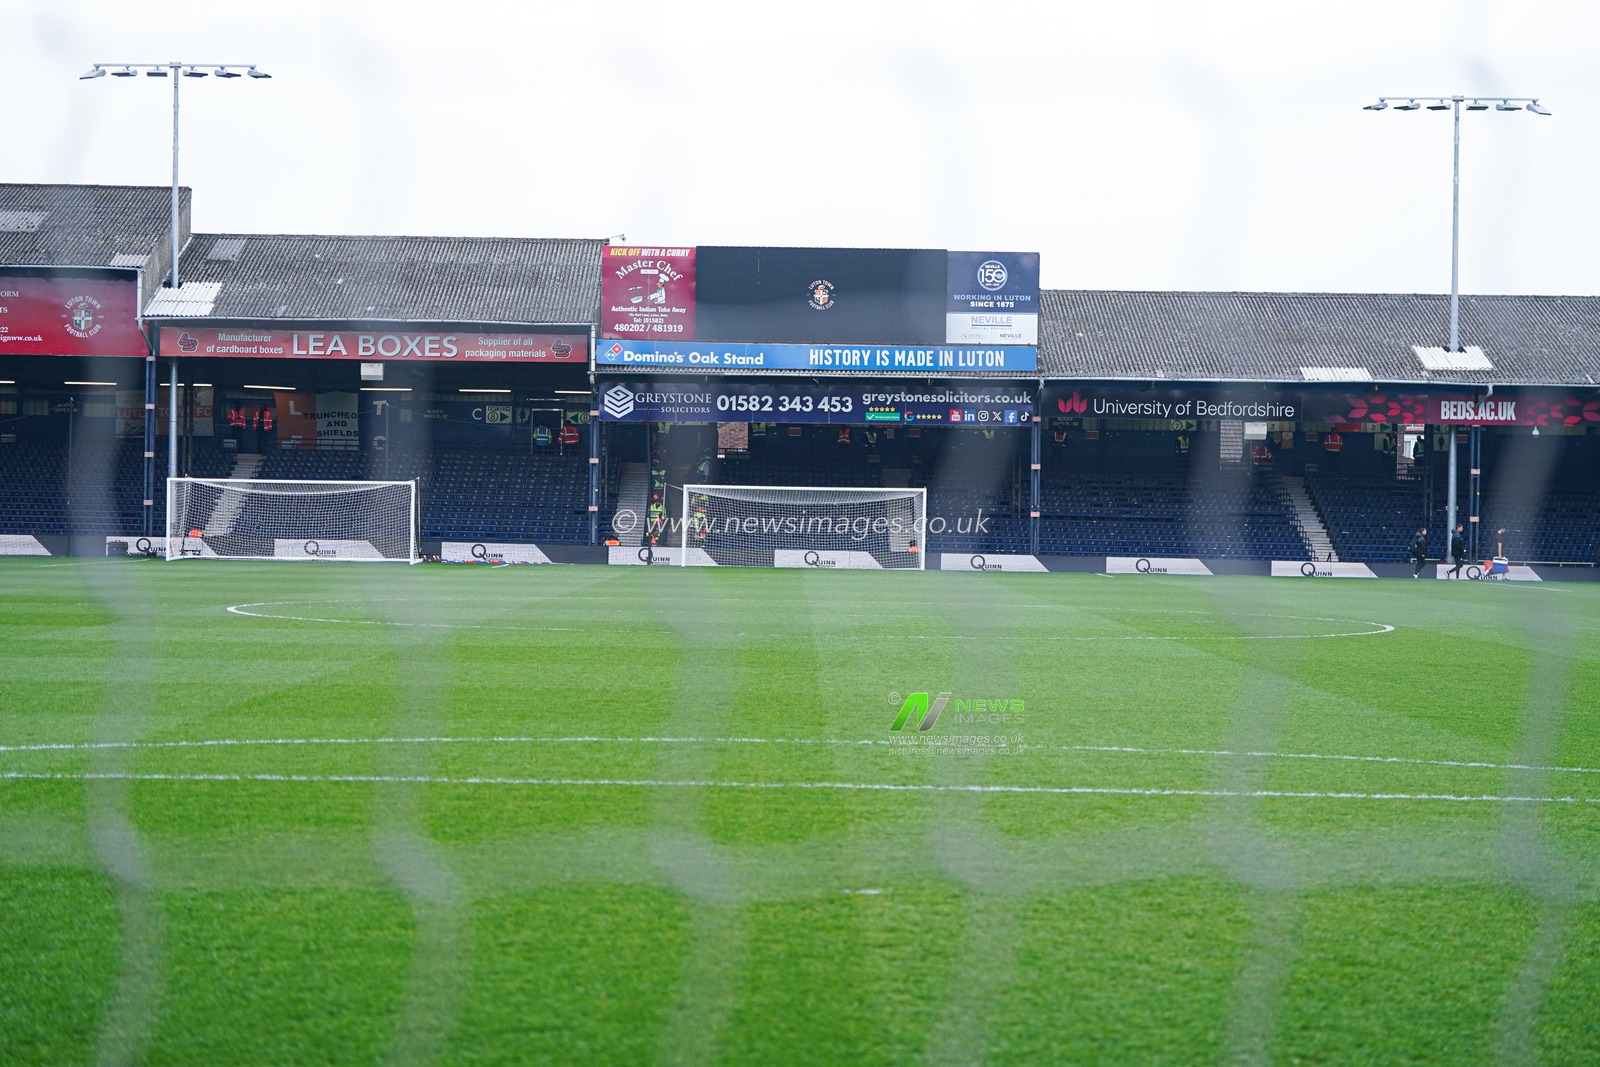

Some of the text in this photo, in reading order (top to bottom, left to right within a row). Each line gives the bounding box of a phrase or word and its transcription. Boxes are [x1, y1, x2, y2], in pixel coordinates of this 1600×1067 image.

[610, 247, 627, 256] KICK
[628, 248, 641, 256] OFF
[642, 248, 659, 256] WITH
[615, 260, 683, 281] Master Chef
[980, 269, 1006, 283] 150
[808, 280, 834, 290] LUTON TOWN
[65, 296, 102, 309] LUTON TOWN
[64, 323, 102, 338] FOOTBALL CLUB
[218, 333, 272, 342] Manufacturer
[206, 345, 283, 354] of cardboard boxes
[292, 334, 459, 359] LEA BOXES
[478, 337, 533, 348] Supplier of all
[465, 348, 546, 359] packaging materials
[623, 350, 764, 365] Domino's Oak Stand
[810, 349, 1004, 367] HISTORY IS MADE IN LUTON
[635, 393, 853, 413] GREYSTONE 01582 343 453
[862, 391, 1032, 405] greystonesolicitors.co.uk
[117, 407, 212, 418] LUTO TOW FC
[372, 400, 387, 415] T
[472, 408, 482, 420] C
[1094, 398, 1295, 419] University of Bedfordshire
[1441, 401, 1516, 420] BEDS.AC.UK
[303, 411, 357, 420] TRUNCHEO
[373, 436, 386, 450] C
[304, 540, 336, 555] QUINN
[471, 543, 503, 560] QUINN
[638, 547, 670, 565] QUINN
[804, 551, 836, 567] QUINN
[970, 554, 1002, 571] QUINN
[1136, 559, 1167, 574] QUINN
[1301, 562, 1333, 577] QUINN
